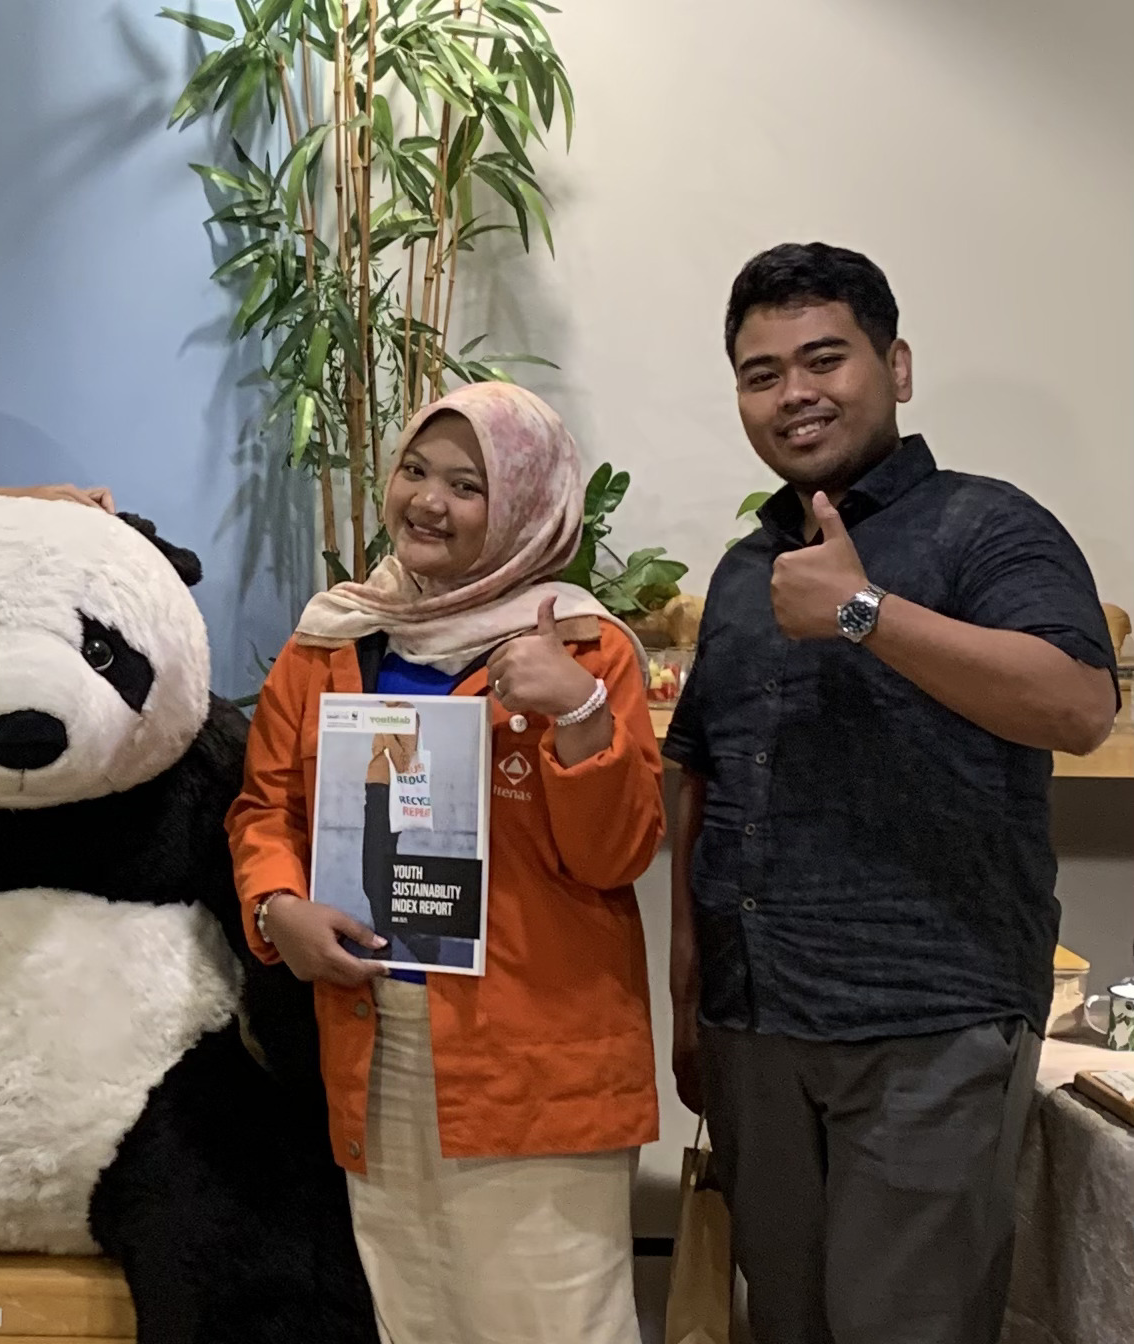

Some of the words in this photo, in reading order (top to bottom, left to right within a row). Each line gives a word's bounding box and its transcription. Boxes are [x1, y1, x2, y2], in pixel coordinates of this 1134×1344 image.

[392, 864, 424, 880] YOUTH
[391, 881, 462, 900] SUSTAINABILITY
[391, 898, 418, 914] INDEX
[419, 900, 454, 916] REPORT
